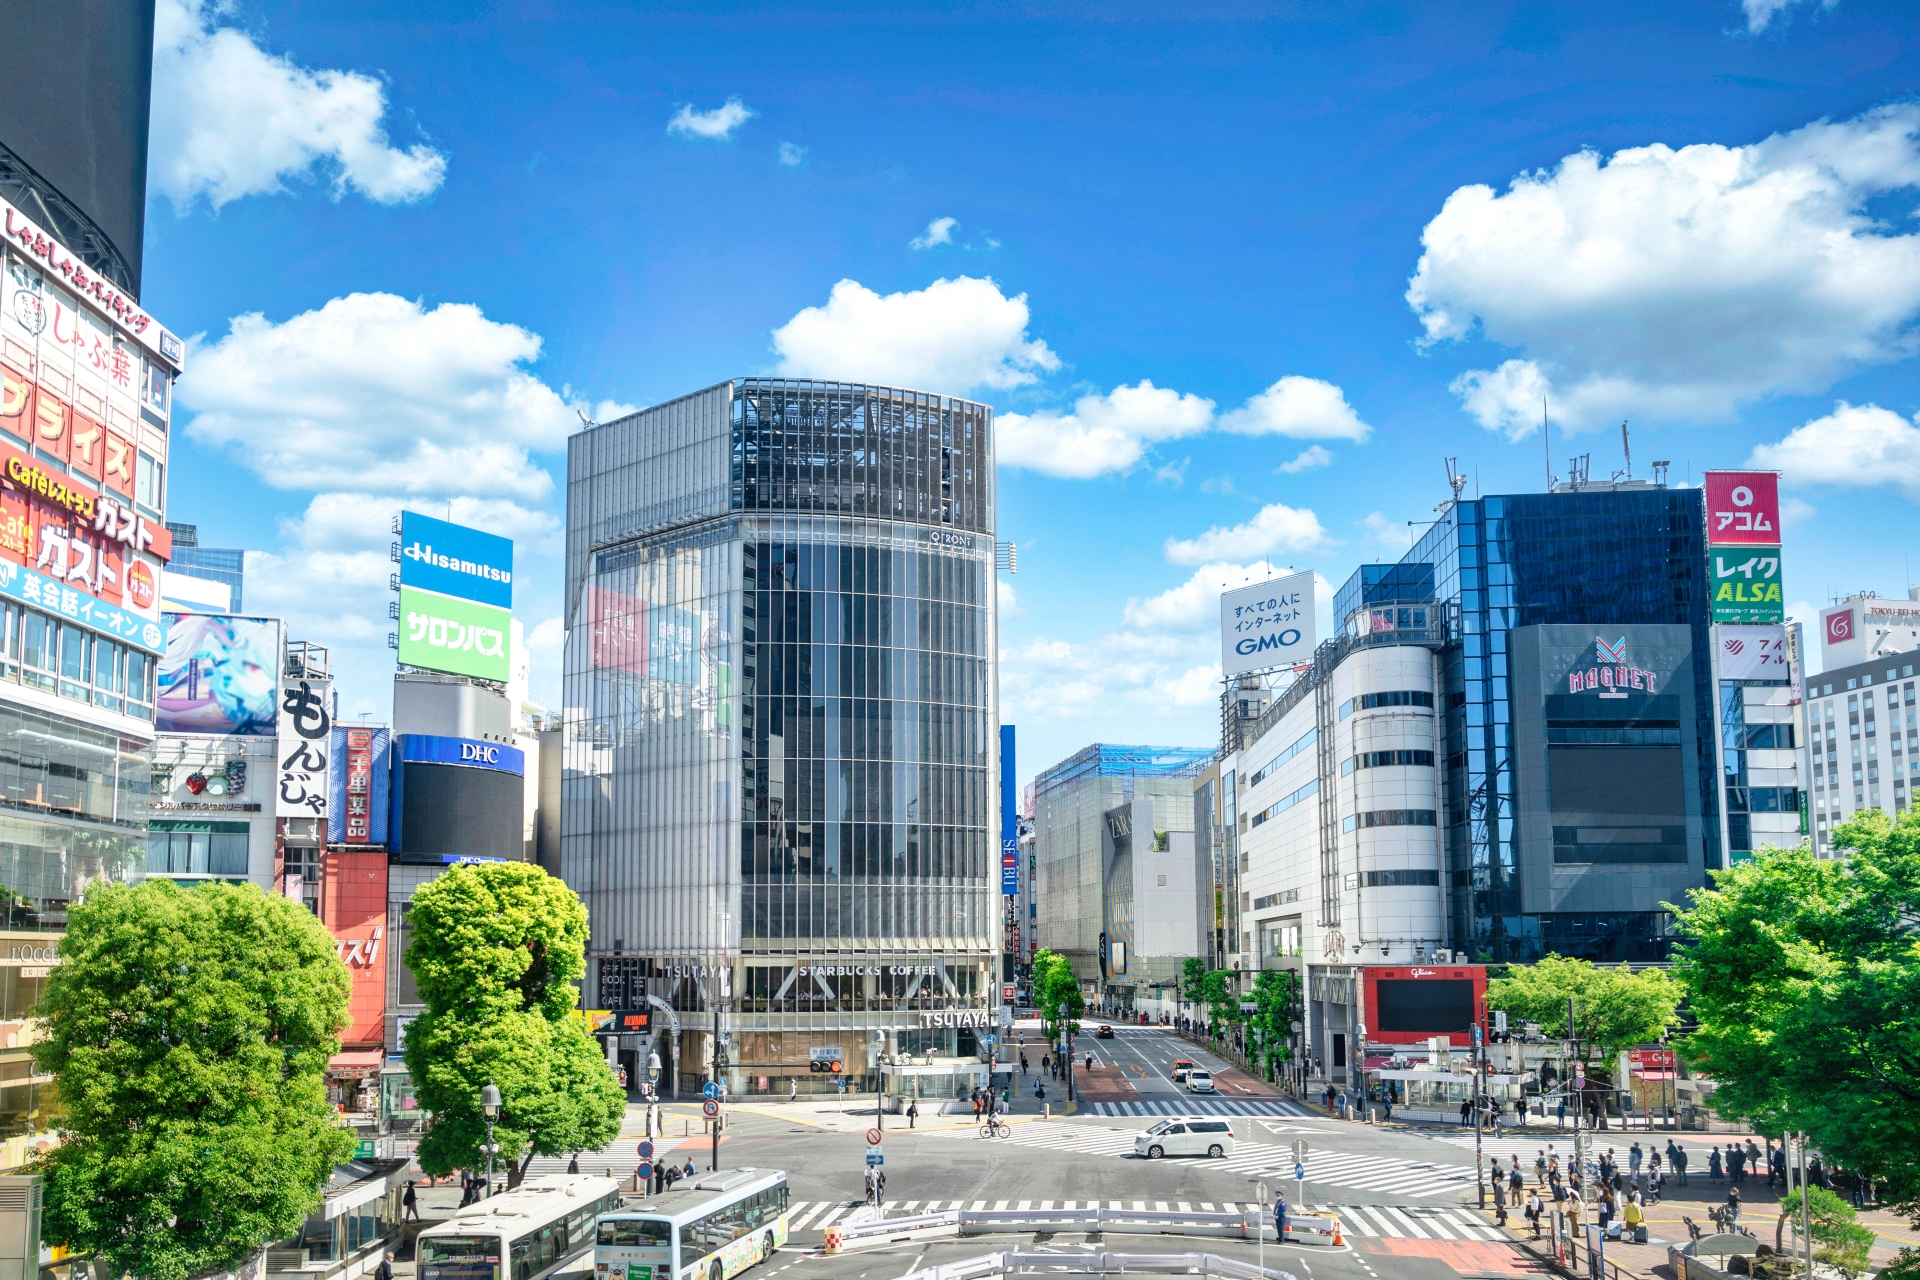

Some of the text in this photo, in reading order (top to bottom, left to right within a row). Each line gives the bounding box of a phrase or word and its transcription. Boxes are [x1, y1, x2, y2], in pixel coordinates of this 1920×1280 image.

[6, 208, 151, 333] しゃぶしゃぶバイキング
[53, 302, 131, 387] しゃぶ葉
[162, 336, 181, 358] 寿司
[95, 497, 153, 550] ガスト
[1715, 511, 1772, 531] アコム
[0, 533, 33, 558] ストラン
[37, 524, 116, 592] ガスト
[404, 541, 511, 583] Hisamitsu
[1716, 556, 1778, 578] レイク
[130, 578, 152, 598] ガスト
[1716, 582, 1782, 602] ALSA
[23, 572, 160, 645] 英会話イーオン 6F
[1235, 593, 1300, 618] すべての人に
[1870, 607, 1895, 616] TOKYU
[1897, 608, 1909, 616] REI
[1235, 608, 1300, 632] インターネット
[407, 611, 504, 659] サロンパス
[1235, 629, 1301, 655] GMO
[1569, 666, 1657, 694] MAGNET
[280, 681, 329, 814] もんじゃ
[461, 743, 498, 763] DHC
[347, 732, 369, 837] 三千里薬品
[1003, 839, 1016, 885] SEIBU
[665, 965, 728, 977] TSUTAYA
[799, 965, 936, 976] STARBUCKS COFFEE
[623, 1014, 648, 1026] ALVARK
[923, 1012, 989, 1026] TSUTAYA
[811, 1048, 840, 1056] 渋谷駅前
